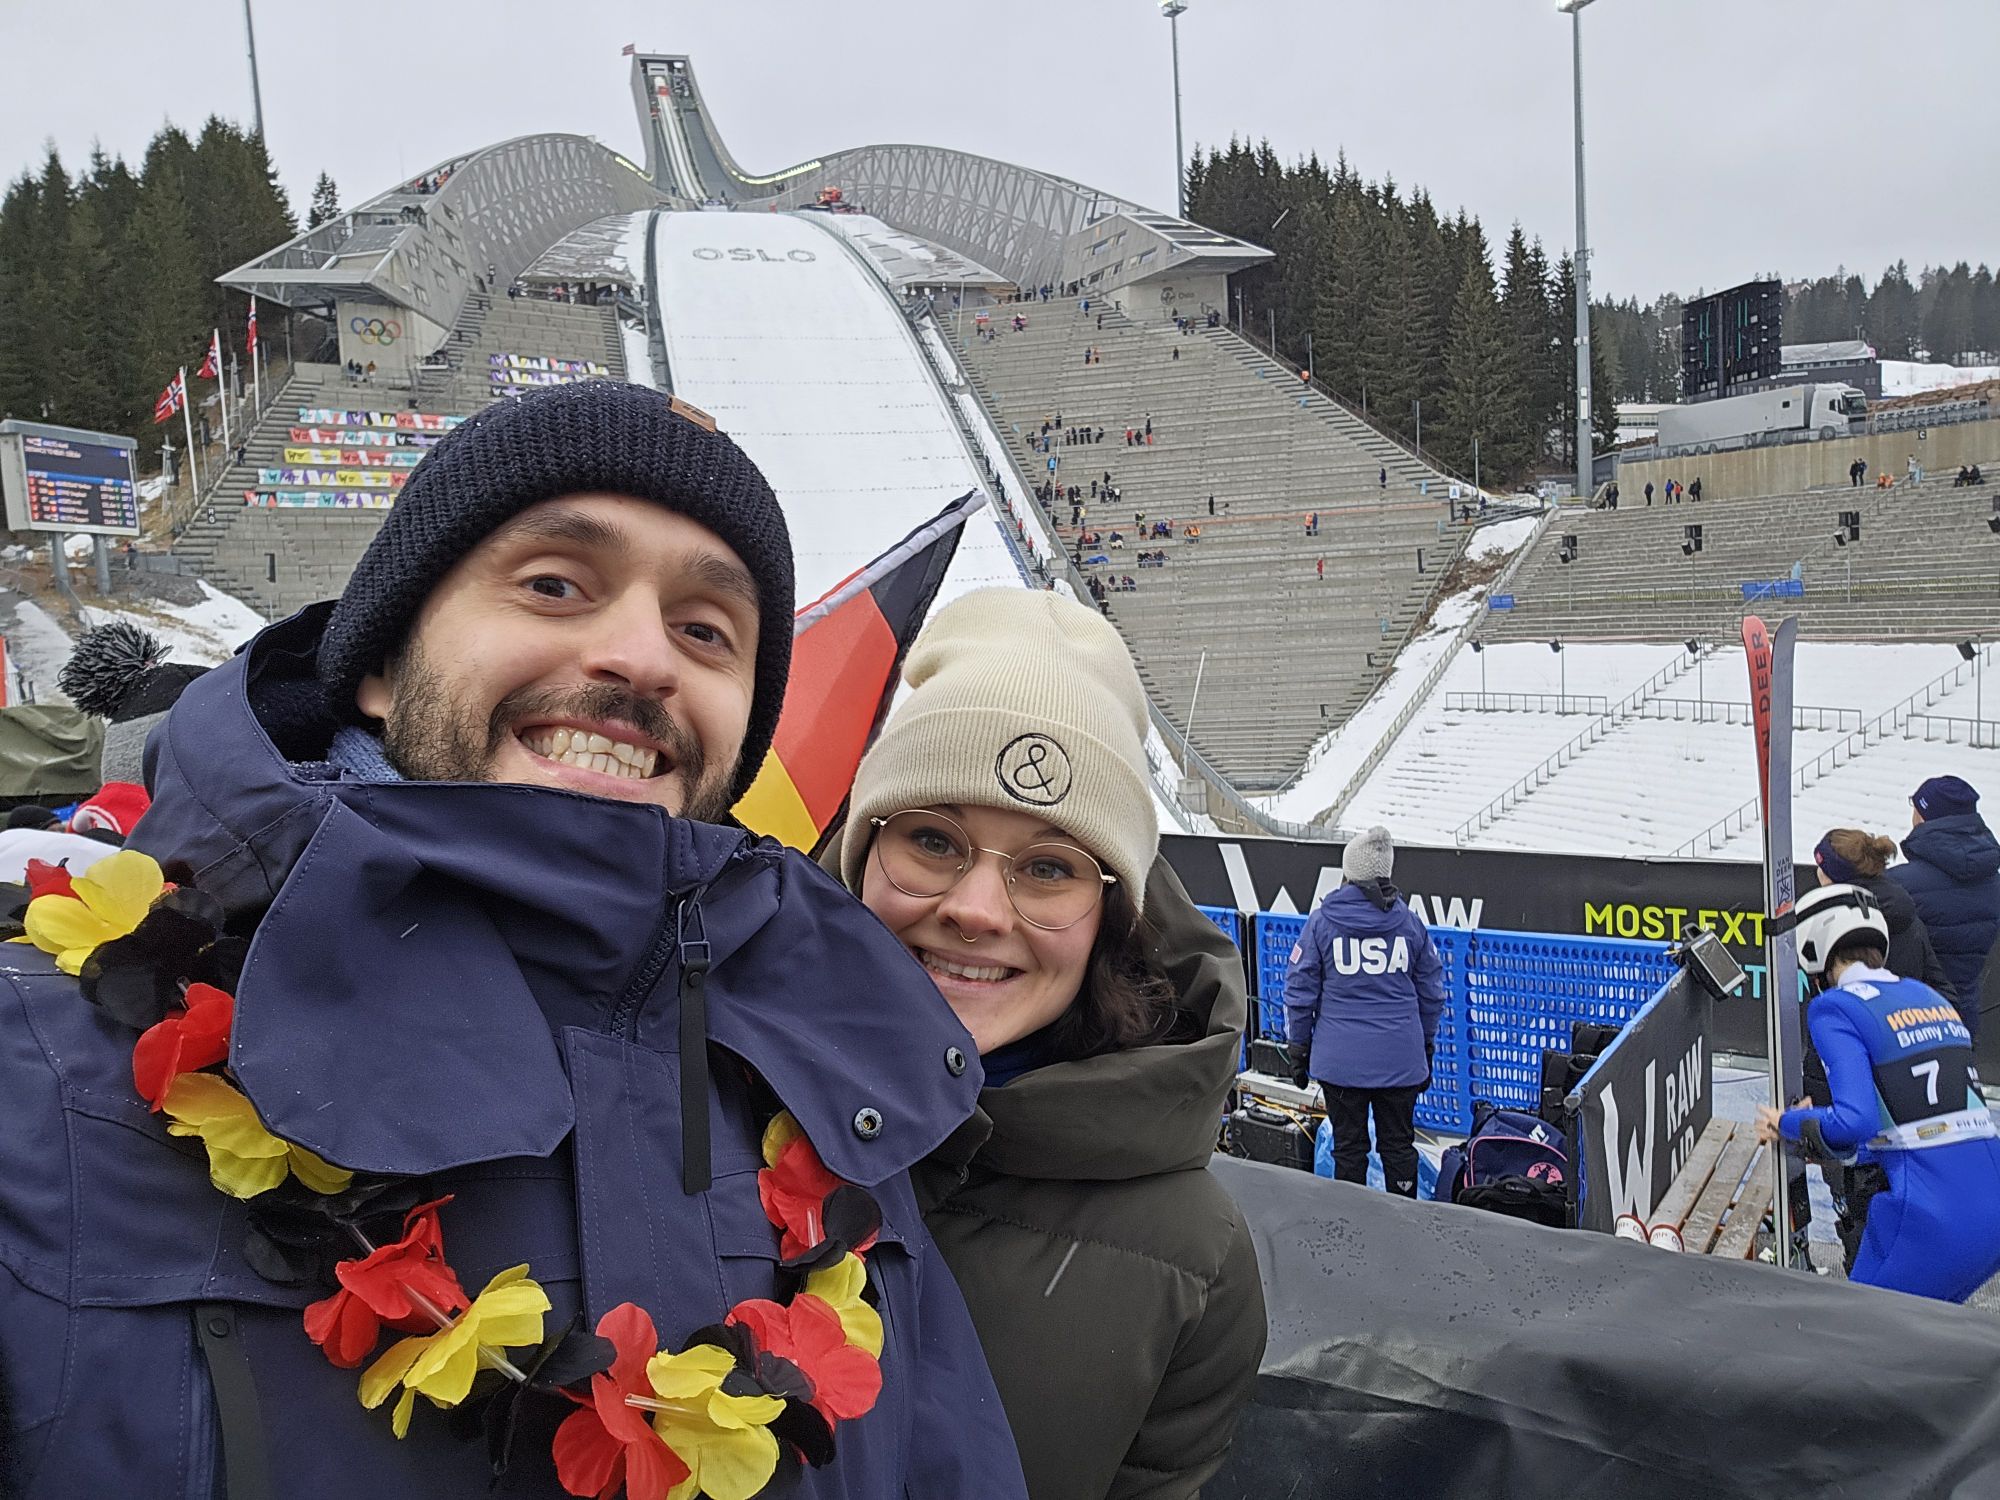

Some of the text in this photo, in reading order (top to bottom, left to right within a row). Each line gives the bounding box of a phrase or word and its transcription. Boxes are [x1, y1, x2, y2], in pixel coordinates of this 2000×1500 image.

[692, 247, 816, 263] OSLO
[1752, 631, 1770, 714] DEER
[1584, 902, 1766, 947] MOST EXT
[1332, 935, 1410, 976] USA
[1896, 1025, 1943, 1049] Bramy
[1911, 1059, 1940, 1106] 7
[1599, 1034, 1703, 1231] W RAW
